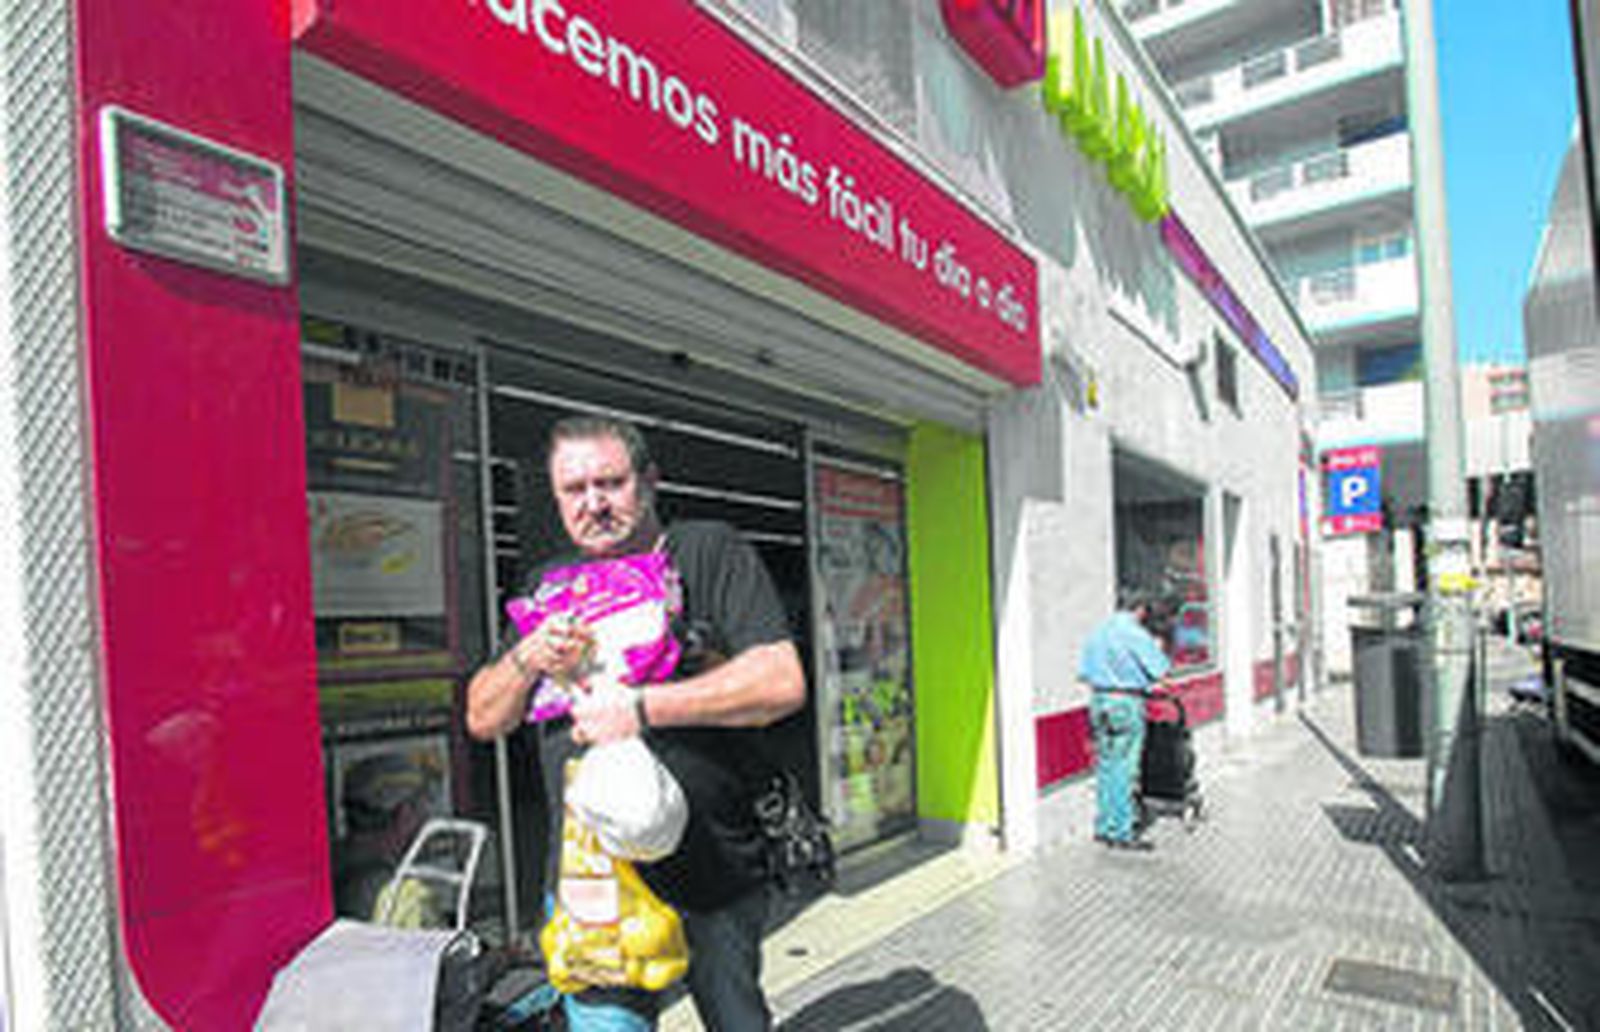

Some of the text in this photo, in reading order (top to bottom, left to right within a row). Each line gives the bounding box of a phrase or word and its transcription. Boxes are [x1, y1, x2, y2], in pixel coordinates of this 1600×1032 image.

[467, 0, 719, 145] acemos
[733, 118, 820, 205] más
[826, 164, 895, 252] fácil
[900, 217, 929, 270] tu
[933, 240, 972, 299] día
[974, 276, 992, 308] a
[1341, 475, 1369, 507] P
